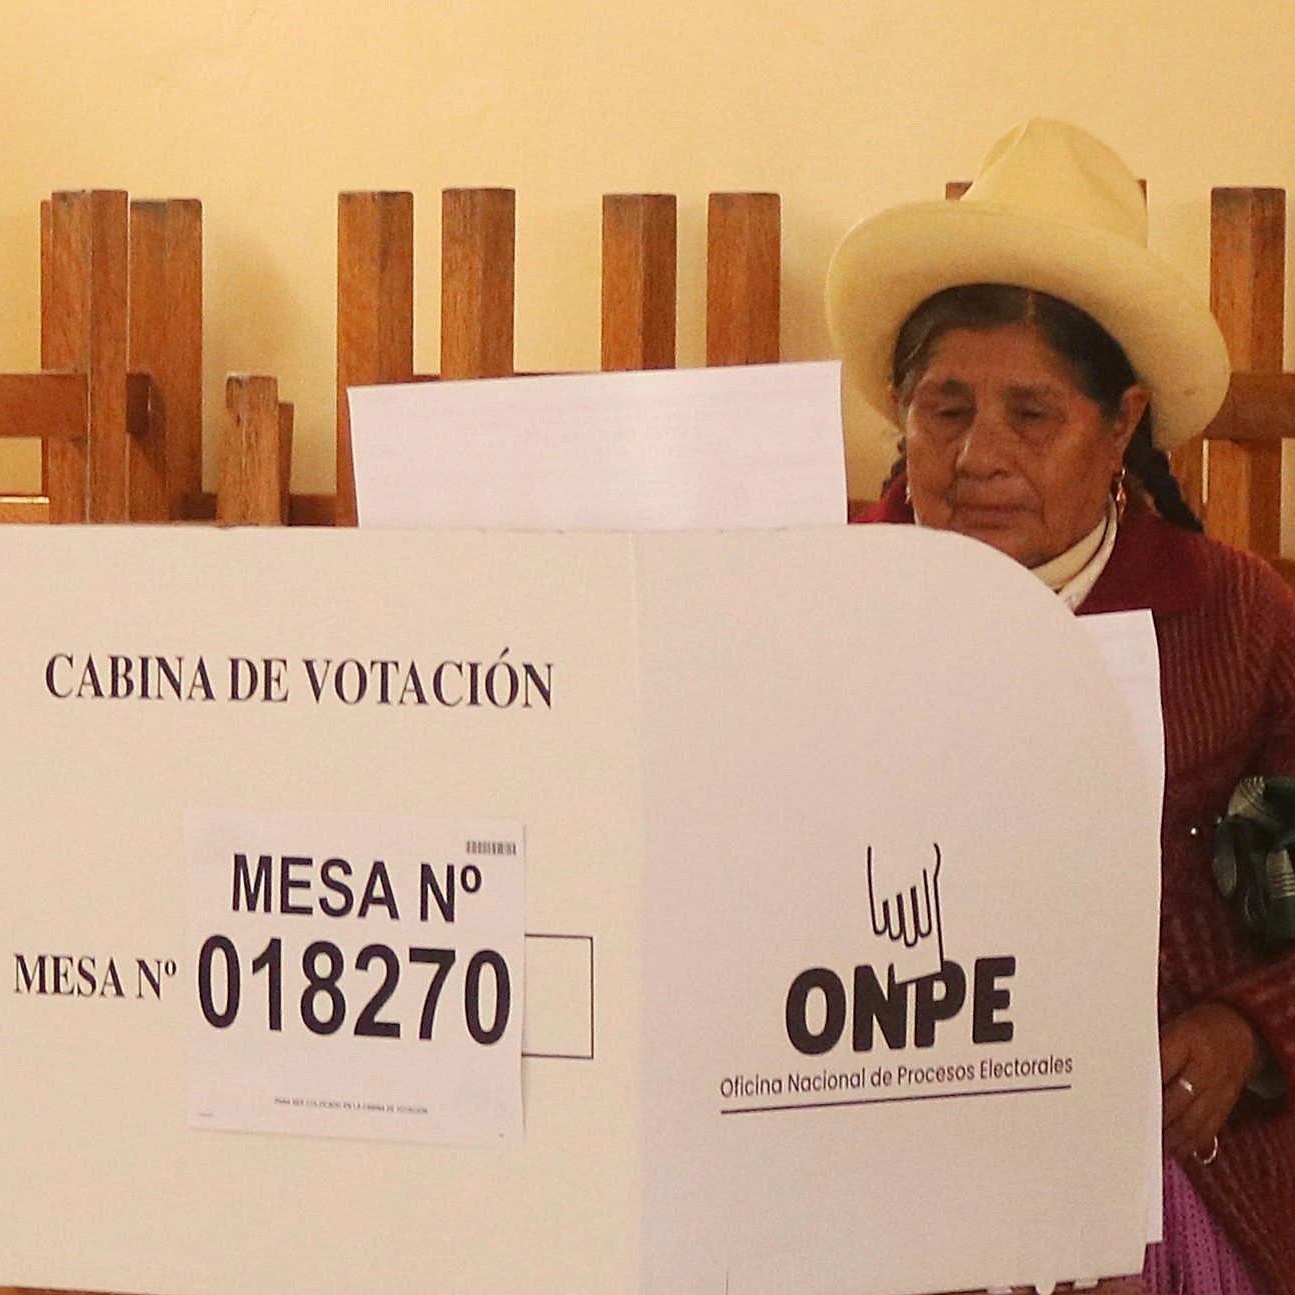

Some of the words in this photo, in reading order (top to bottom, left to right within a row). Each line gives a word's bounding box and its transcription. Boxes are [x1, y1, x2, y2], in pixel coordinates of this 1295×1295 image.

[45, 654, 215, 701] CABINA
[228, 657, 290, 703] DE
[303, 647, 553, 709] VOTACIÓN
[232, 853, 400, 921] MESA
[15, 953, 125, 998] MESA
[198, 934, 511, 1046] 018270
[785, 955, 1016, 1057] ONPE
[720, 1076, 783, 1098] Oficina
[788, 1067, 867, 1093] Nacional
[870, 1067, 894, 1087] de
[897, 1065, 976, 1086] Procesos
[979, 1055, 1074, 1080] Electorales
